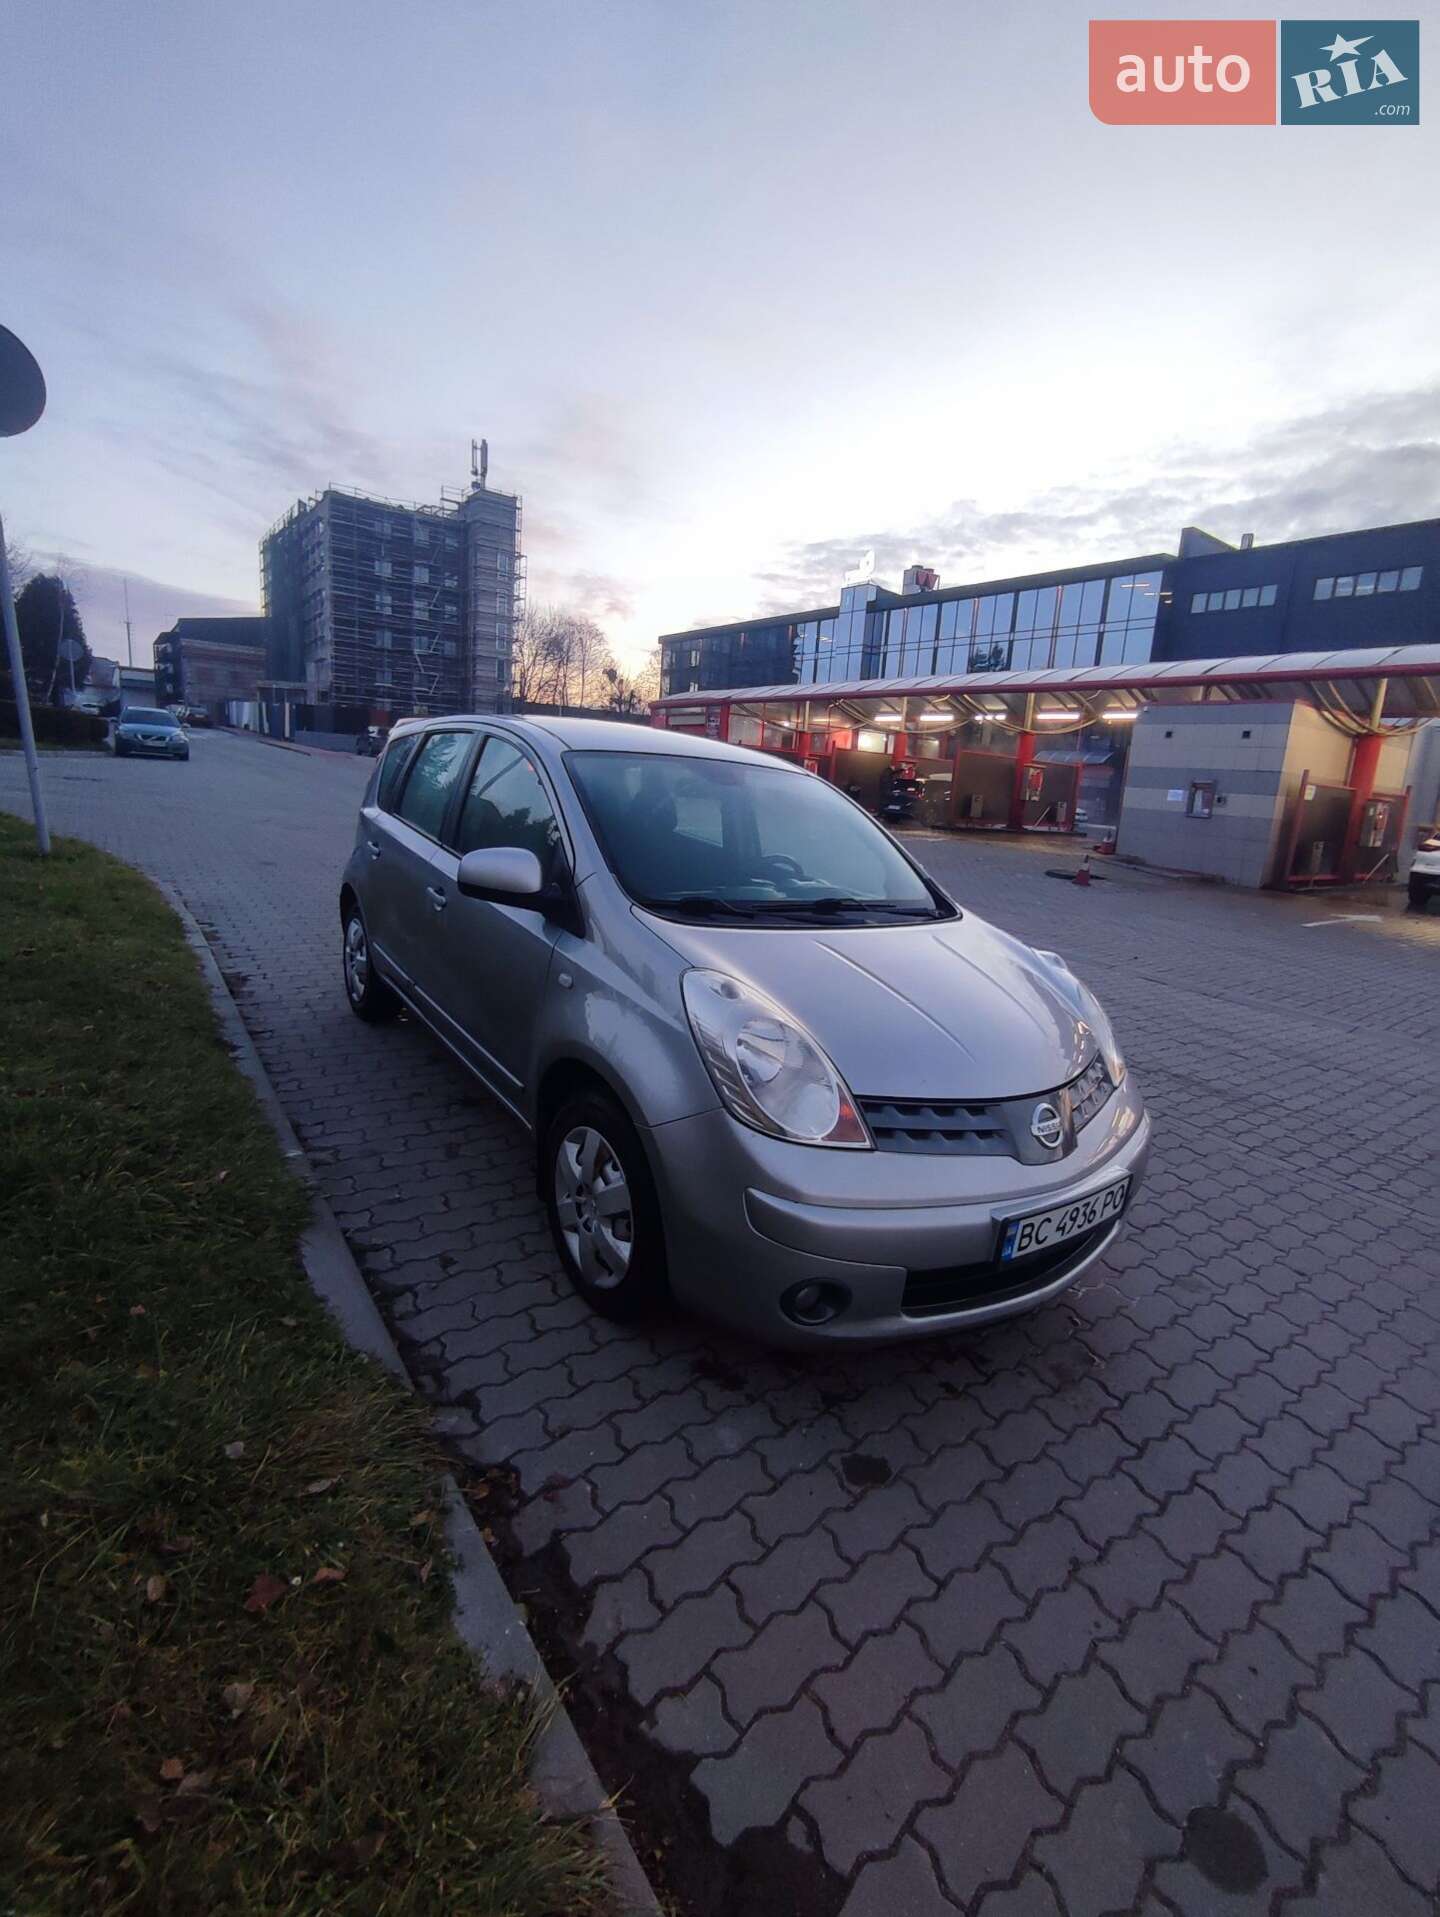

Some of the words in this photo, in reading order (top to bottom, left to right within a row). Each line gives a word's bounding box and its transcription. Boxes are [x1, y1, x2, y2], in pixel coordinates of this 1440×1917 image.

[1017, 1217, 1052, 1252] BC
[1055, 1196, 1100, 1237] 4936
[1100, 1183, 1125, 1219] PO
